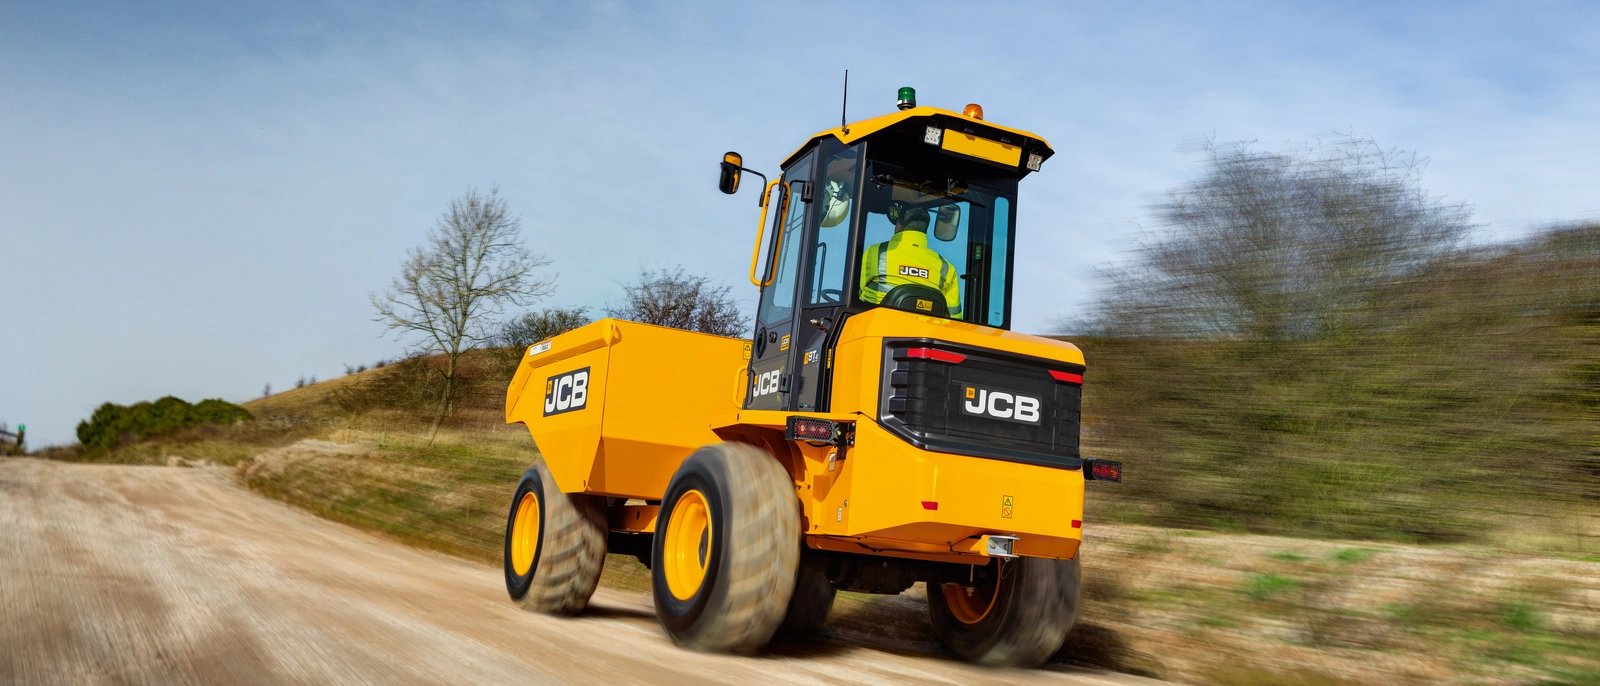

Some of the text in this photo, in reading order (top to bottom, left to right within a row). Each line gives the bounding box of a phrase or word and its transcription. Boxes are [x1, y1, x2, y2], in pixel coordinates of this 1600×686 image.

[900, 266, 929, 279] JCB
[545, 371, 589, 413] JCB
[753, 369, 780, 397] JCB
[965, 389, 1040, 422] JCB
